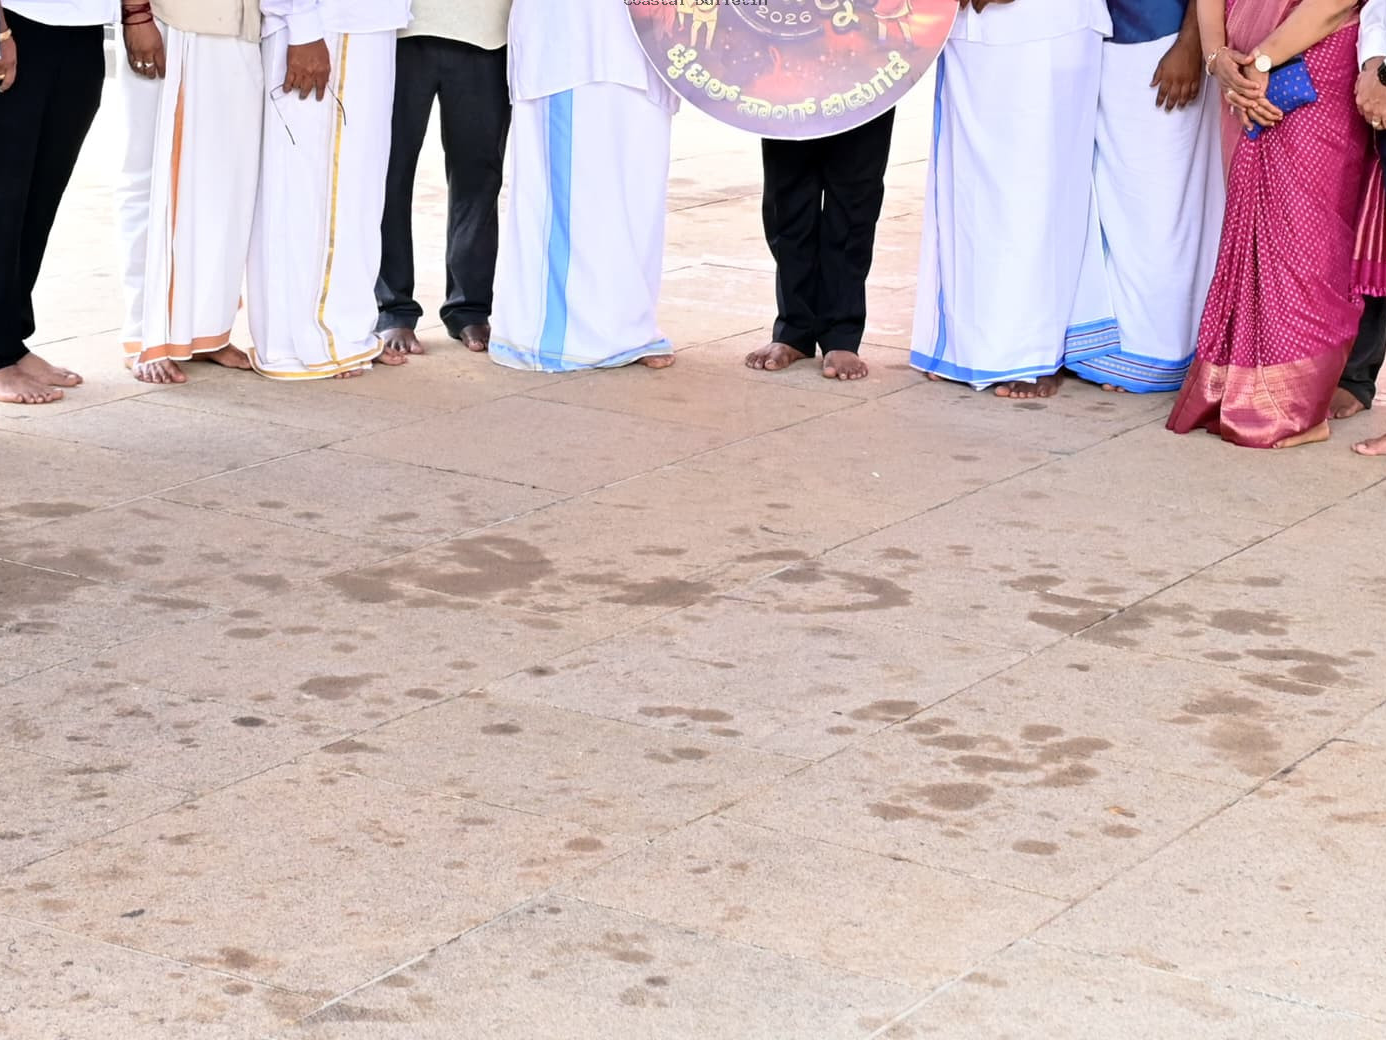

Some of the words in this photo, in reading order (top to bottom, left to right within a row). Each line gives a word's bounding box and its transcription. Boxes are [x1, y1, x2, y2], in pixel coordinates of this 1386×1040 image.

[755, 5, 812, 25] 2026
[667, 43, 741, 101] ಟೈಟಲ್
[737, 95, 817, 121] ಸಾಂಗ್
[821, 50, 910, 118] ಬಿಡುಗಡೆ
